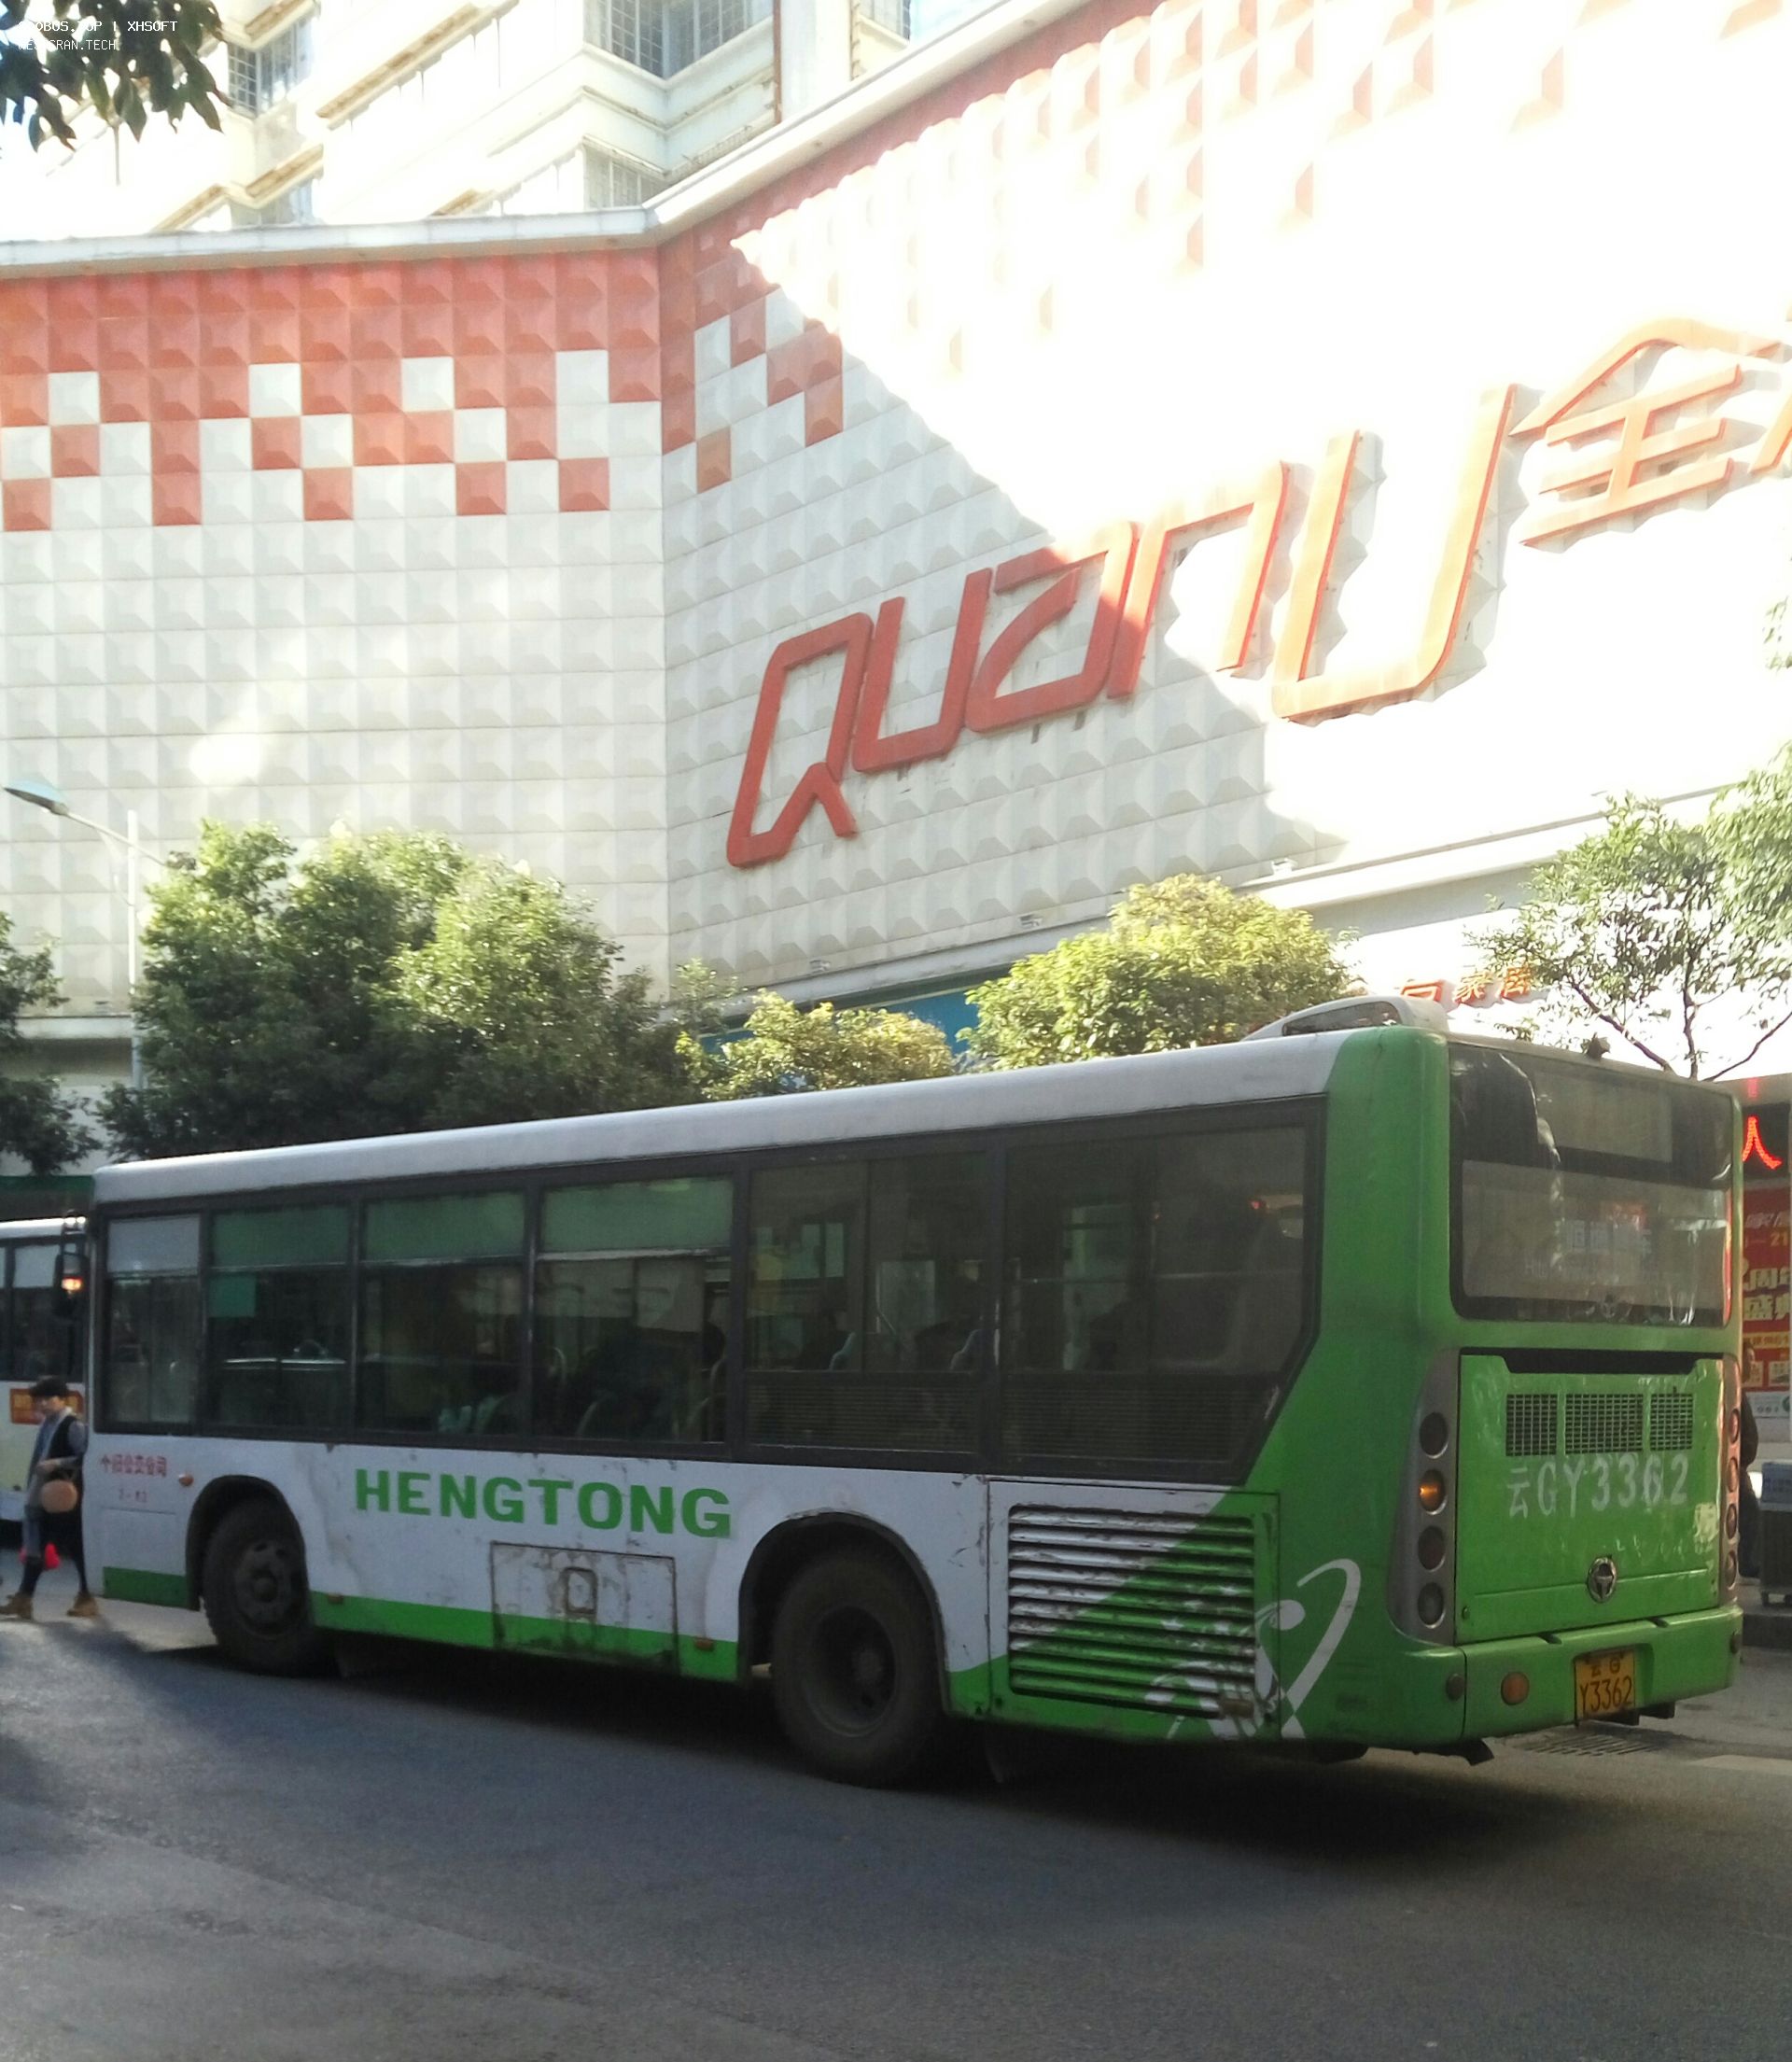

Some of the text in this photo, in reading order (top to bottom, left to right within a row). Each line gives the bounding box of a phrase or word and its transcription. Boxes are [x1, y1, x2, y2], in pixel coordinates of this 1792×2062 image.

[1505, 317, 1792, 547] 全
[356, 1468, 731, 1539] HENGTONG
[1579, 1674, 1632, 1715] Y3362
